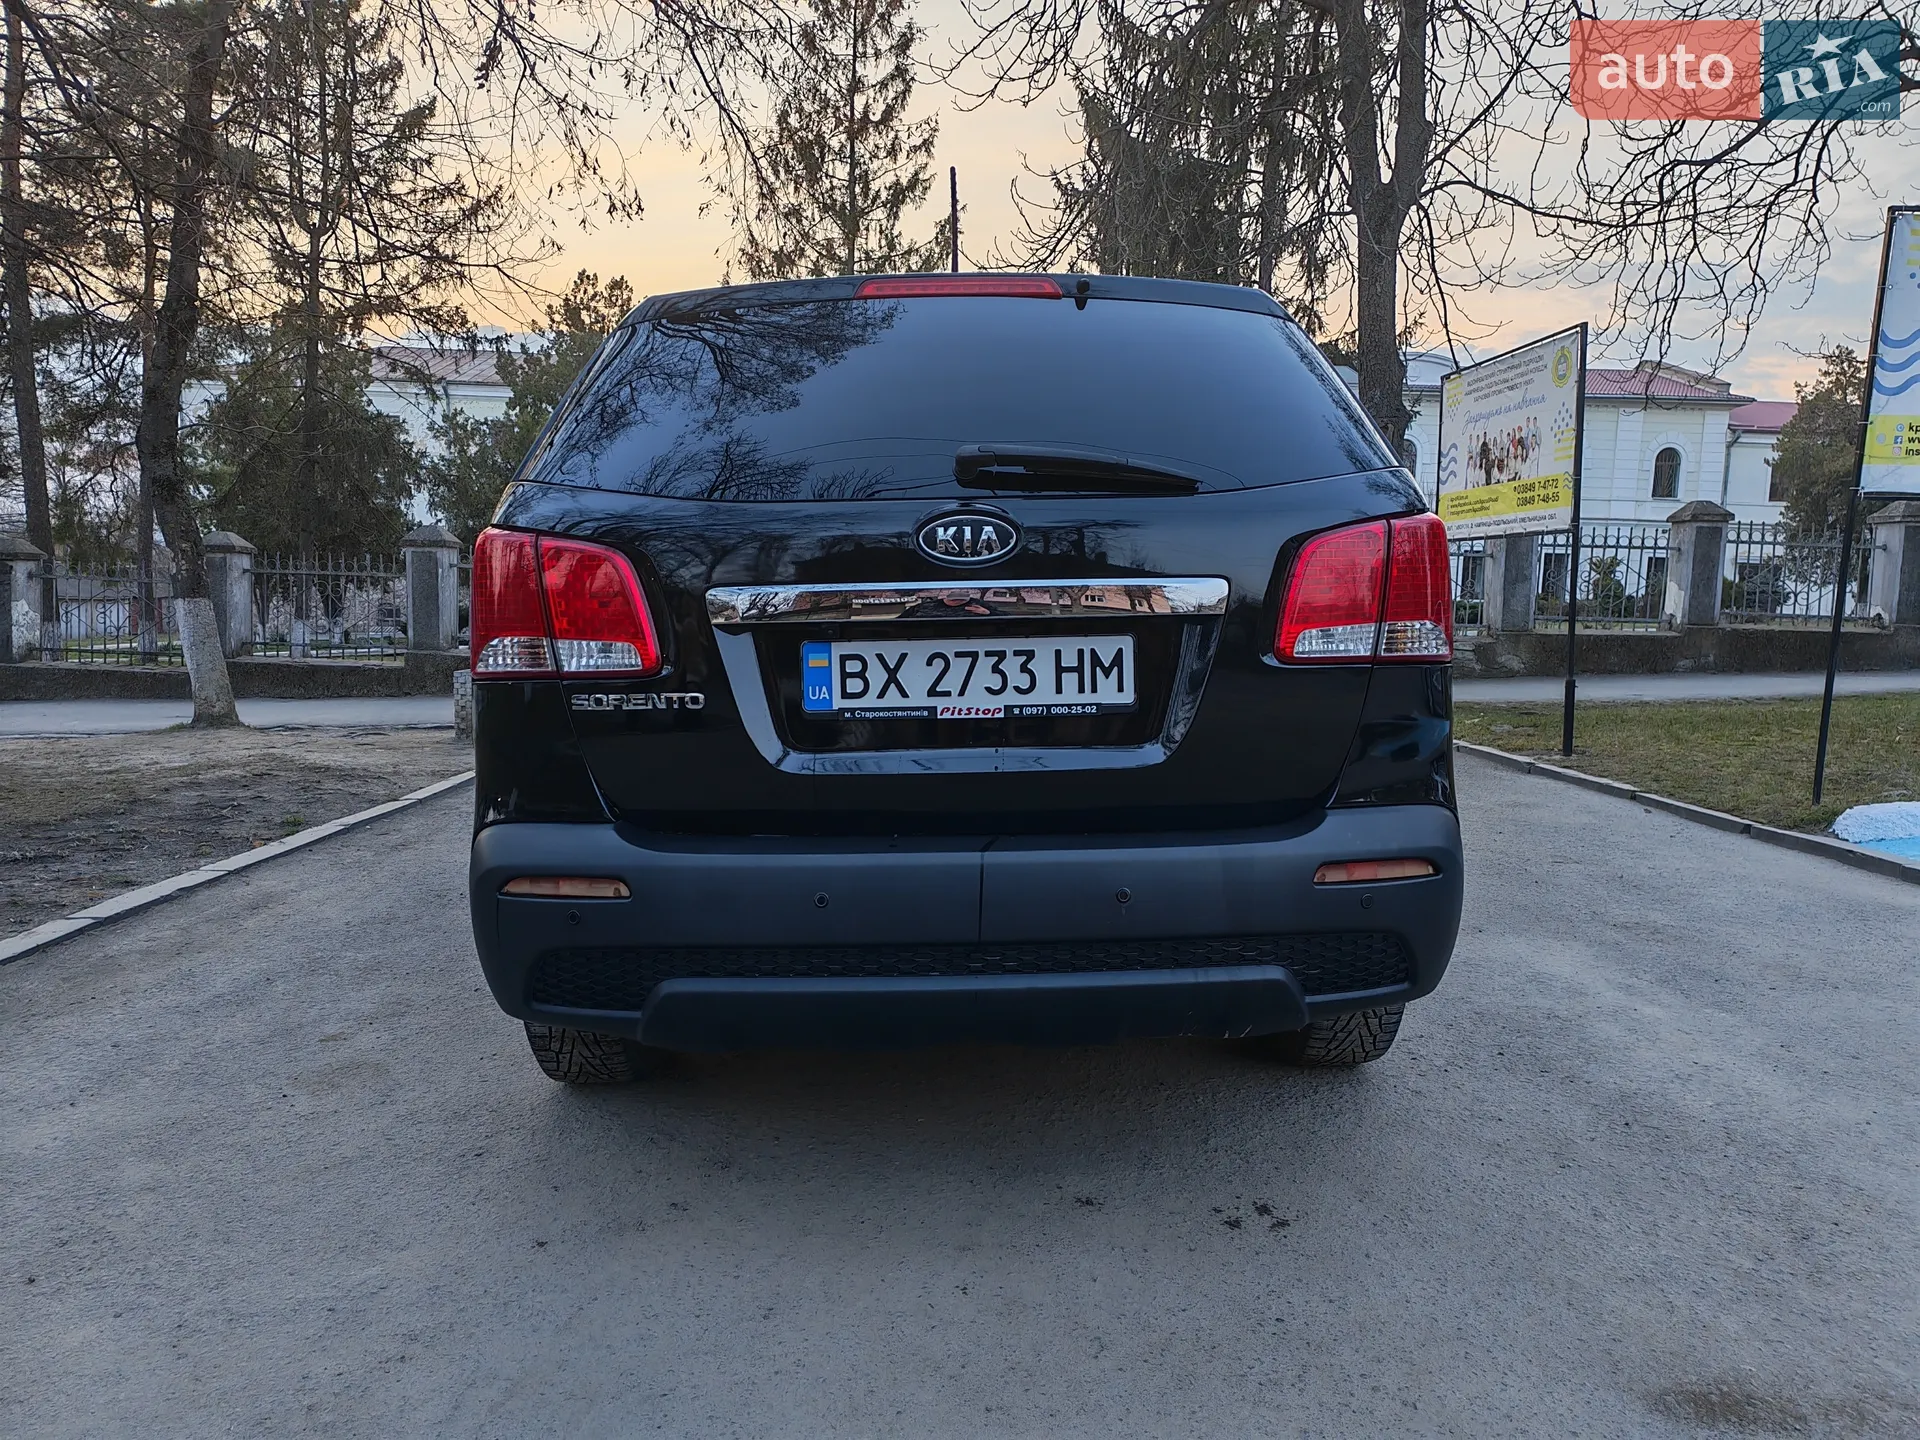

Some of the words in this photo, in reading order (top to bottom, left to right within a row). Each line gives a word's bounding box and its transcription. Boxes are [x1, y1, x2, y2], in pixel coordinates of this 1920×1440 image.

[1516, 482, 1536, 494] 03849
[1537, 478, 1559, 491] 7-47-72
[1516, 495, 1535, 507] 03849
[1537, 491, 1560, 504] 7-48-55
[935, 525, 1001, 553] KIA
[839, 652, 911, 699] BX
[926, 649, 1037, 697] 2733
[1054, 647, 1125, 694] HM
[808, 686, 830, 700] UA
[571, 693, 705, 710] SORENTO
[855, 708, 928, 719] Старокостянтинів
[939, 705, 1003, 718] PitStop
[1022, 705, 1047, 716] (097)
[1051, 705, 1097, 715] 000-25-02
